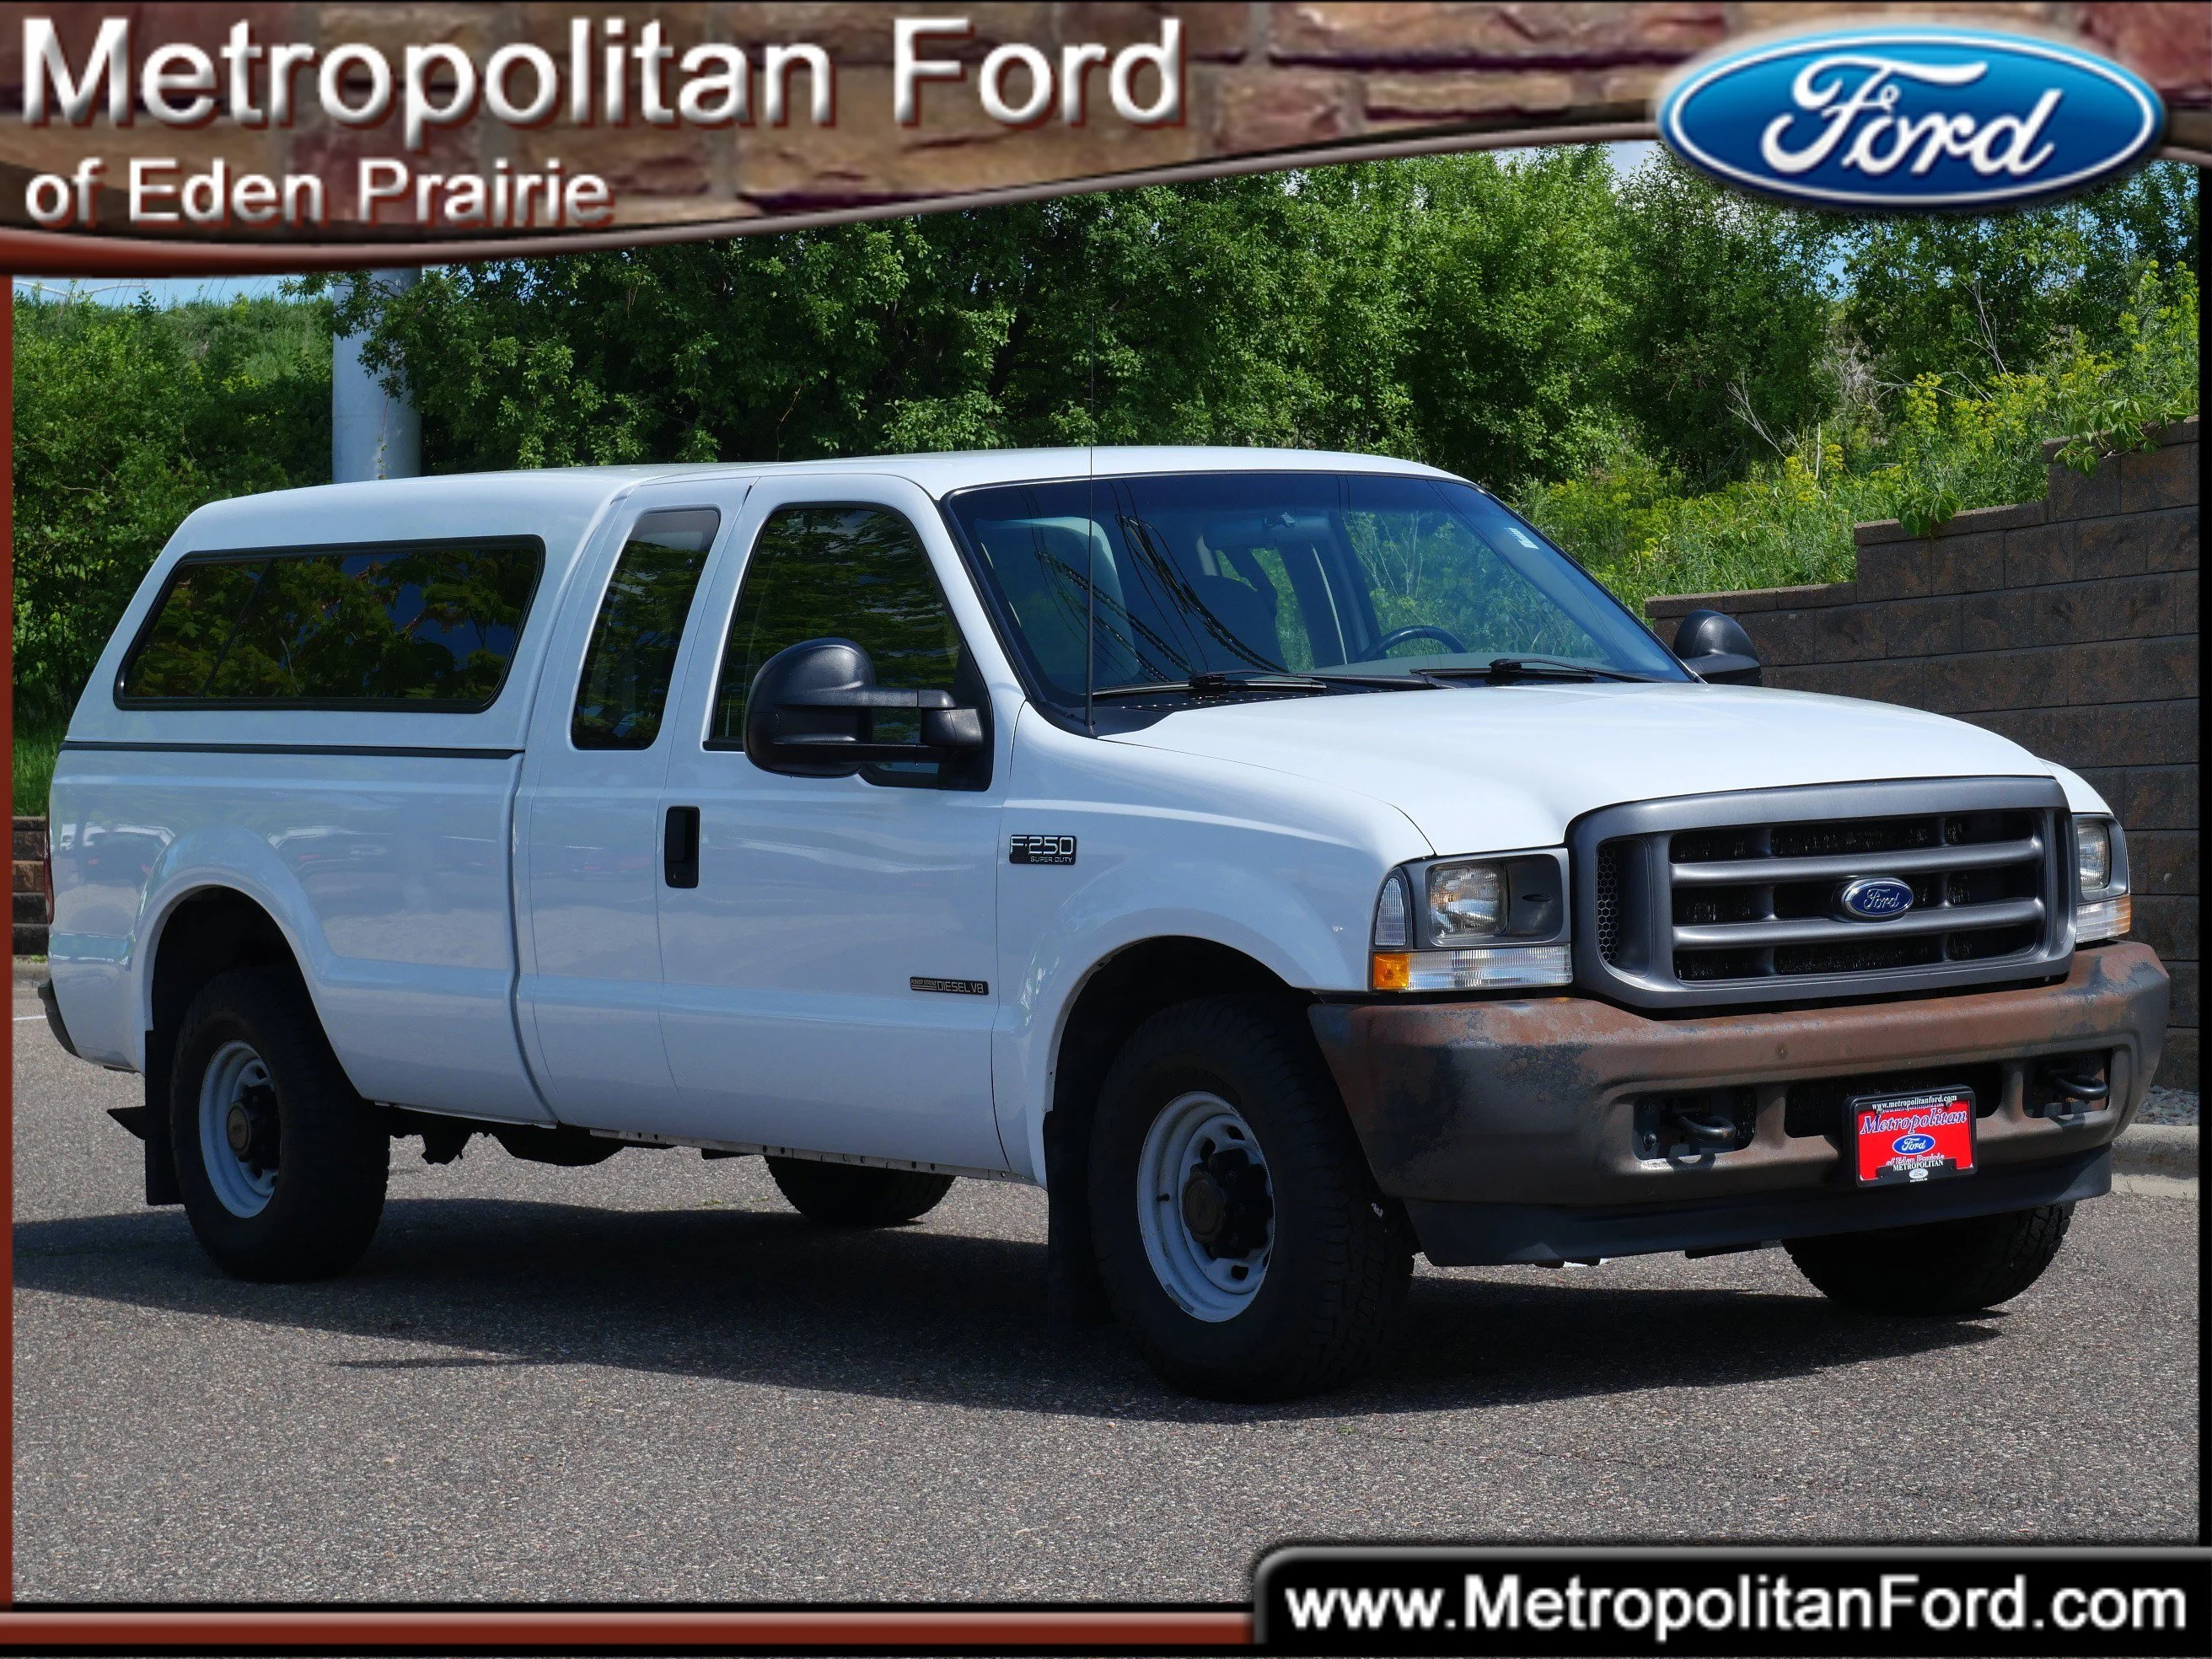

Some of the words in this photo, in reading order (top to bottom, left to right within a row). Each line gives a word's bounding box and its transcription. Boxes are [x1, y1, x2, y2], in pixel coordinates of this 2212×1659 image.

[1863, 888, 1900, 910] Ford
[937, 980, 971, 993] DIESEL
[971, 984, 984, 993] V8
[1871, 1094, 1957, 1110] www.metropolitanford.com
[1860, 1108, 1967, 1135] Metropolitan
[1901, 1137, 1927, 1152] Ford
[1893, 1158, 1944, 1172] METROPOLITAN
